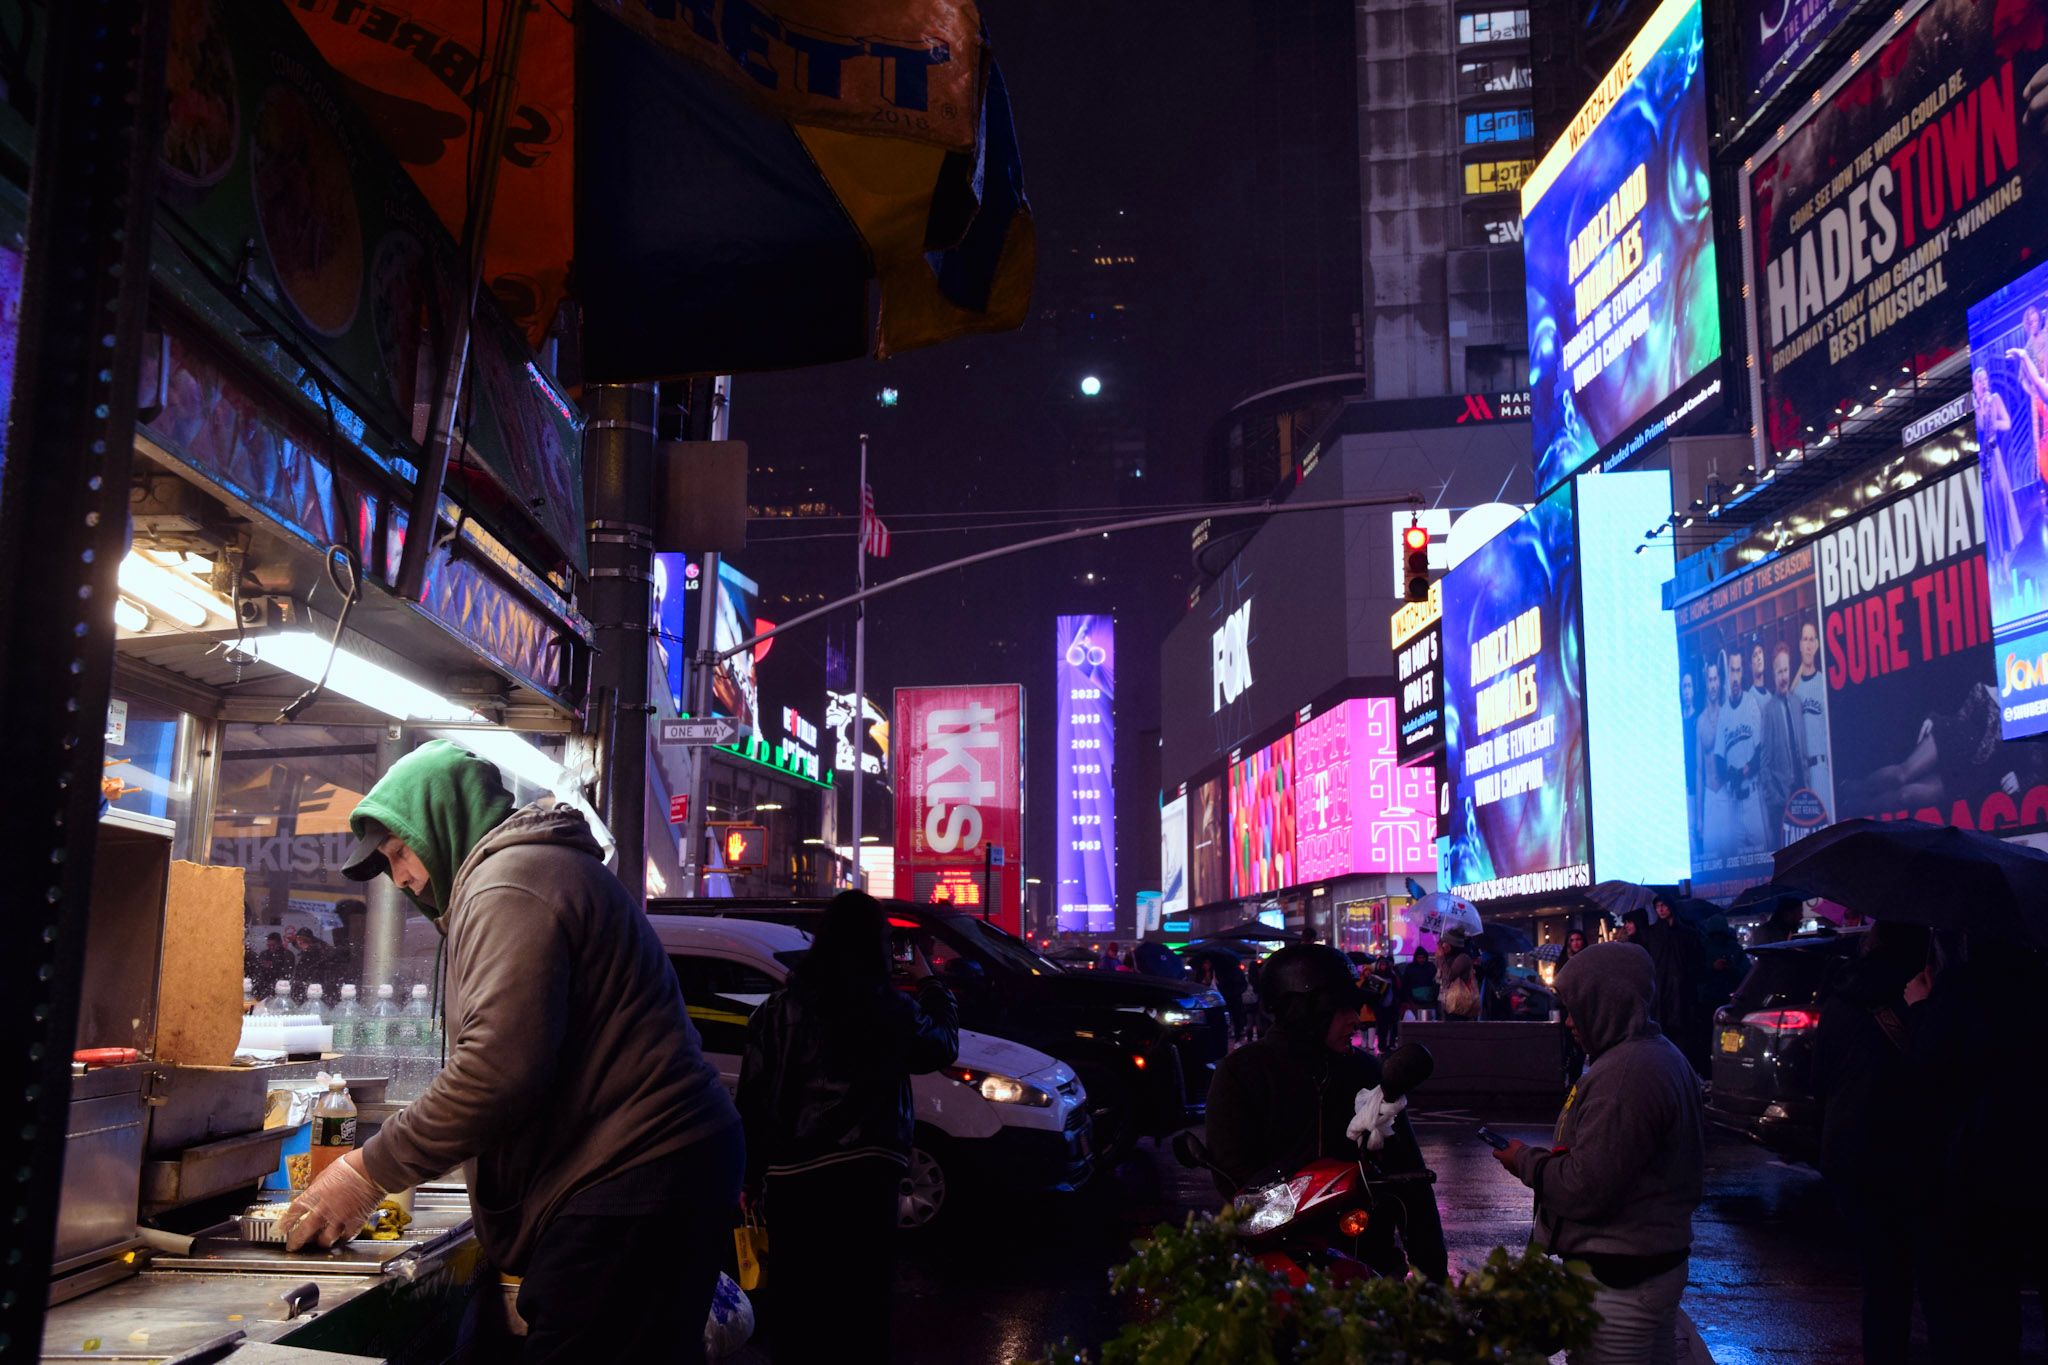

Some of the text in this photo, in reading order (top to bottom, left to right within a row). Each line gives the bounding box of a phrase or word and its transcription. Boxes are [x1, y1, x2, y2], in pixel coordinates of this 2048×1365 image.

[1568, 50, 1633, 153] WATCH LIVE
[1788, 199, 1815, 236] COME
[1815, 182, 1832, 214] SEE
[1831, 162, 1853, 198] HOW
[1854, 146, 1874, 179] THE
[1873, 113, 1911, 162] WORLD
[1910, 82, 1948, 132] COULD
[1766, 58, 2019, 347] HADESTOWN
[1772, 312, 1835, 375] BROADWAY'S
[1835, 288, 1865, 329] TONY
[1867, 270, 1892, 308] AND
[1828, 260, 1948, 366] BEST MUSICAL
[1904, 397, 1966, 443] OUTFRONT
[1604, 443, 1630, 473] Included
[1630, 433, 1645, 454] with
[1645, 420, 1665, 444] Prime
[685, 580, 699, 590] LG
[1729, 581, 1742, 603] HIT
[1744, 575, 1754, 596] OF
[1757, 567, 1773, 590] THE
[1774, 547, 1812, 583] SEASON!
[1212, 597, 1254, 713] FOX
[1411, 635, 1430, 673] MAY
[1430, 630, 1438, 661] 5
[1827, 586, 1910, 691] SURE
[1071, 688, 1100, 700] 2023
[1422, 670, 1434, 704] ET
[670, 726, 728, 738] ONE WAY
[1071, 713, 1100, 725] 2013
[1071, 738, 1100, 750] 2003
[926, 702, 1000, 854] tkts
[1071, 763, 1100, 775] 1993
[1071, 788, 1100, 800] 1983
[1071, 814, 1100, 826] 1973
[915, 836, 924, 853] Fund
[1071, 840, 1100, 852] 1963
